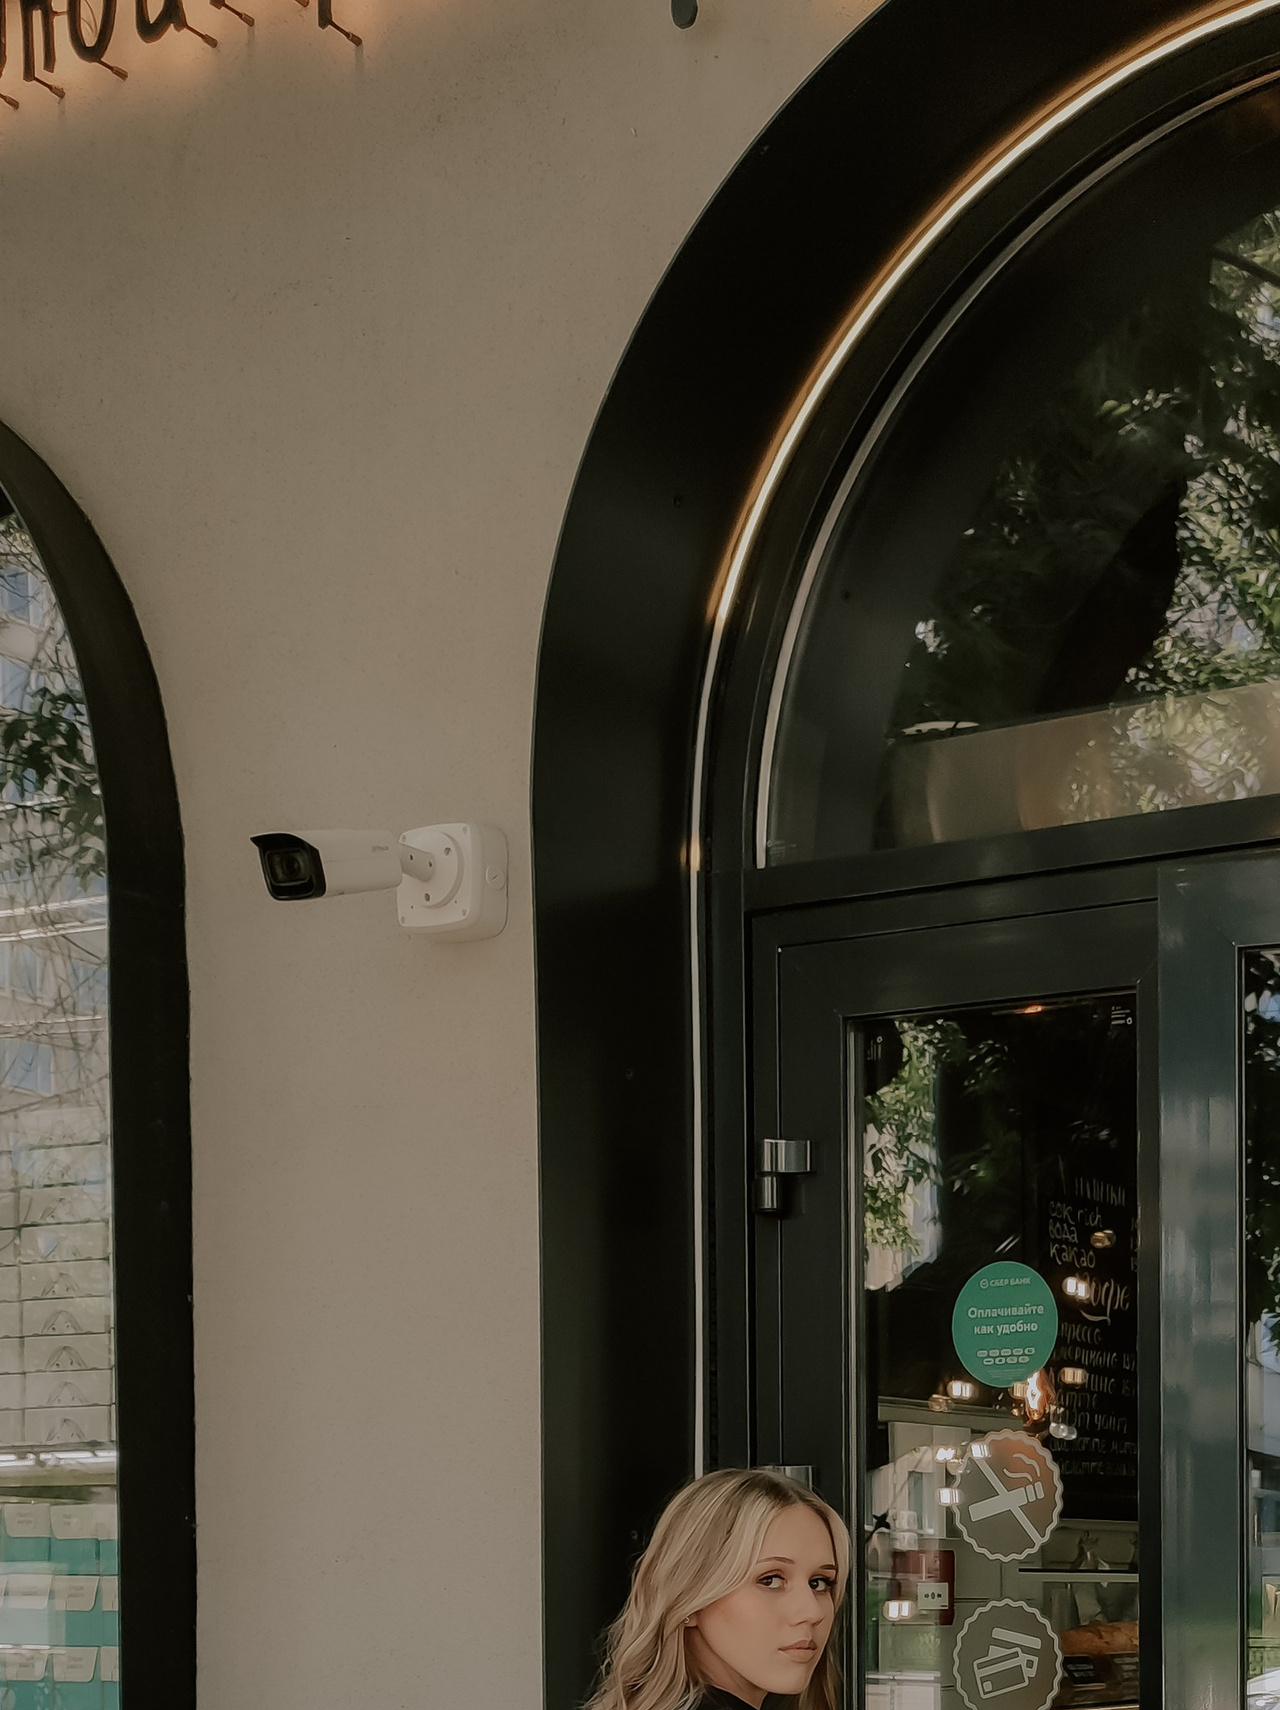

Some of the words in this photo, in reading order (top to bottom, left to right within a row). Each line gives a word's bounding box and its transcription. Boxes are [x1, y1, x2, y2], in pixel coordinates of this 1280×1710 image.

[967, 1303, 1044, 1318] Оплачивайте
[974, 1325, 994, 1334] как
[997, 1320, 1038, 1336] удобно
